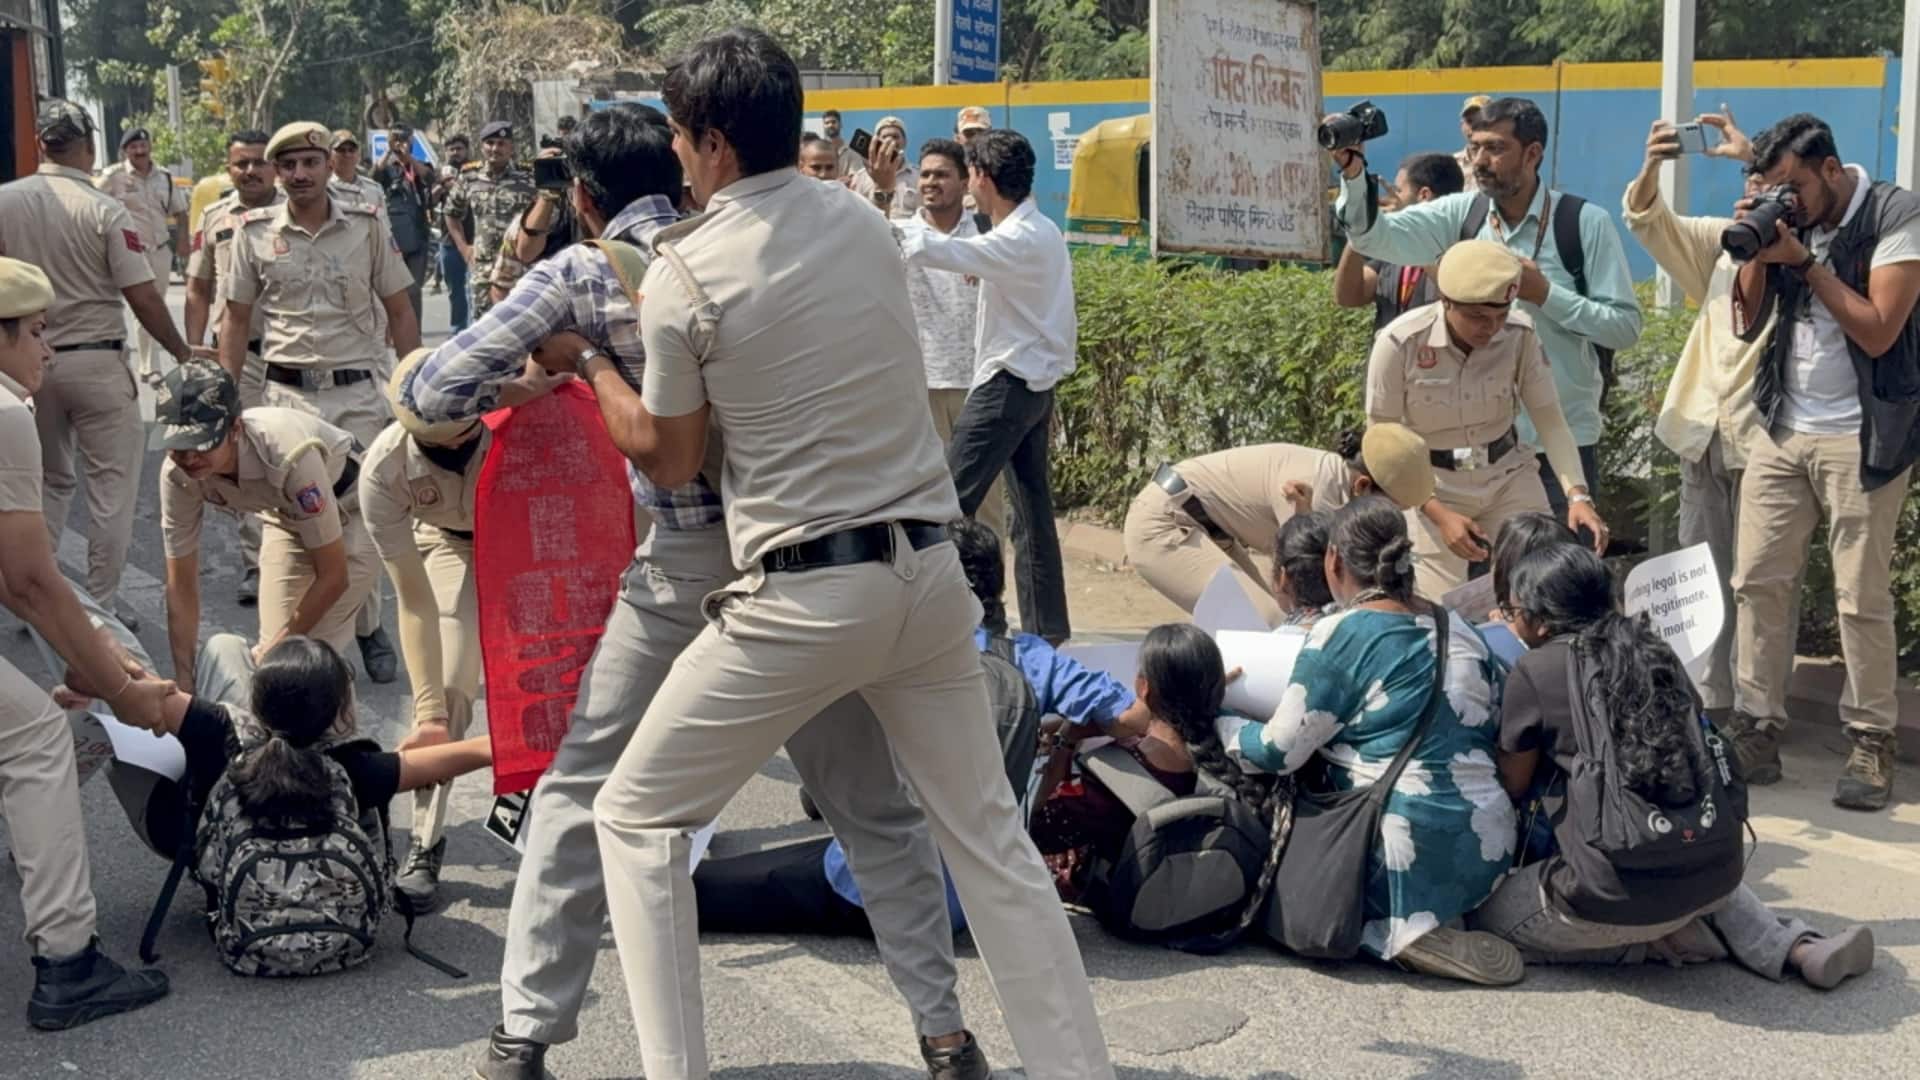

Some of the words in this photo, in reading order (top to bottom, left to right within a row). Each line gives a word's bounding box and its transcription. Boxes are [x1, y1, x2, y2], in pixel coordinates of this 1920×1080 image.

[960, 35, 973, 49] New
[974, 37, 989, 53] Delhi
[1651, 572, 1676, 593] legal
[1678, 569, 1689, 583] is
[1690, 563, 1707, 579] not
[1651, 589, 1710, 617] legitimate.
